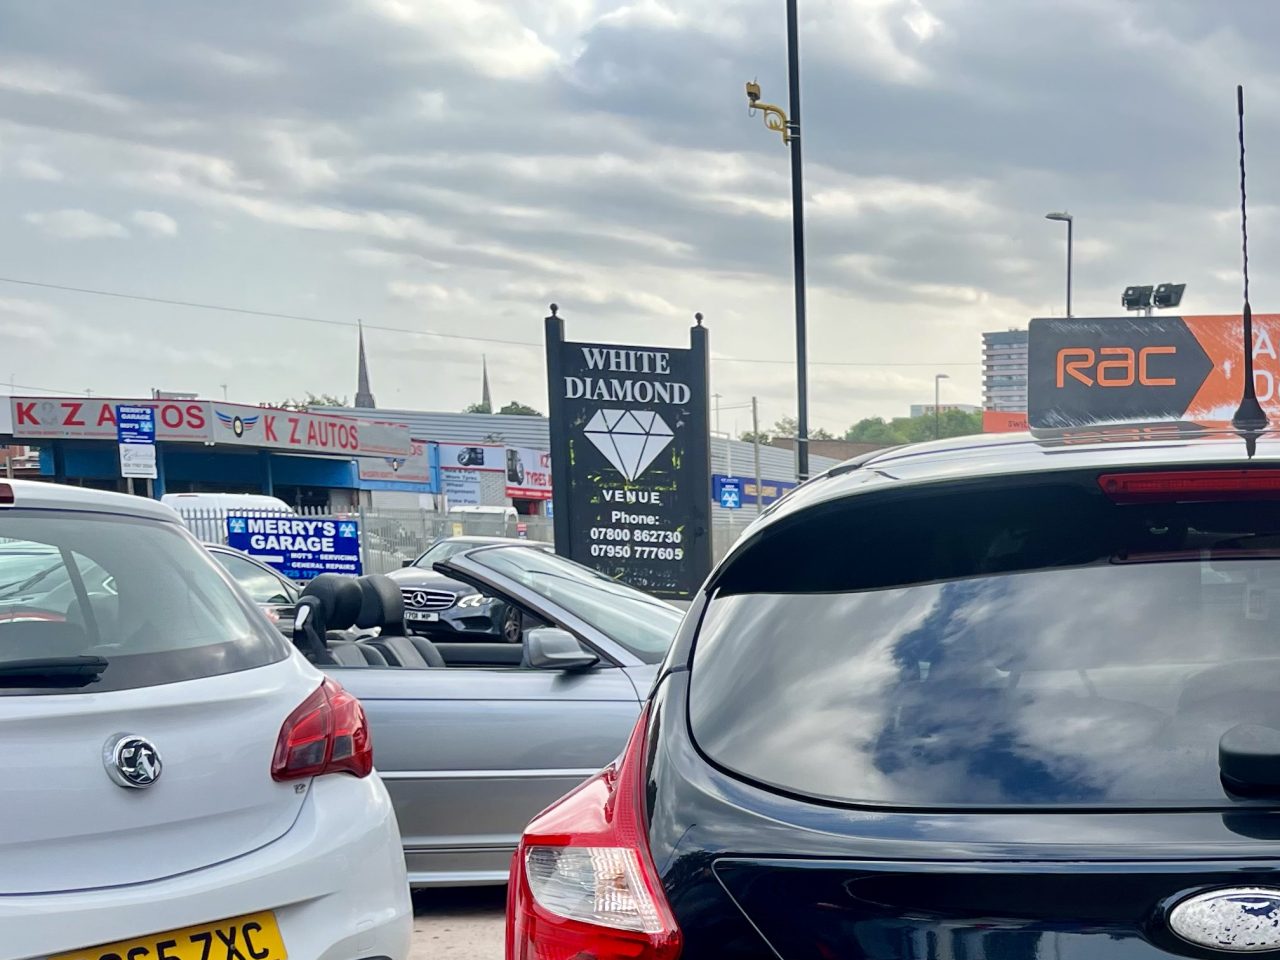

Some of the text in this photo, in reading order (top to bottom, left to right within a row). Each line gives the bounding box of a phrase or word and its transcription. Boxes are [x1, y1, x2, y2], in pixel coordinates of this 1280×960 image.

[581, 347, 670, 374] WHITE
[564, 376, 691, 404] DIAMOND
[97, 403, 205, 429] AOS
[307, 420, 359, 450] AUTOS
[602, 490, 660, 504] VENUE
[612, 511, 660, 525] Phone:
[248, 519, 336, 537] MERRY'S
[590, 528, 681, 543] 07800 862730
[250, 535, 335, 552] GARAGE
[591, 545, 630, 557] 07950
